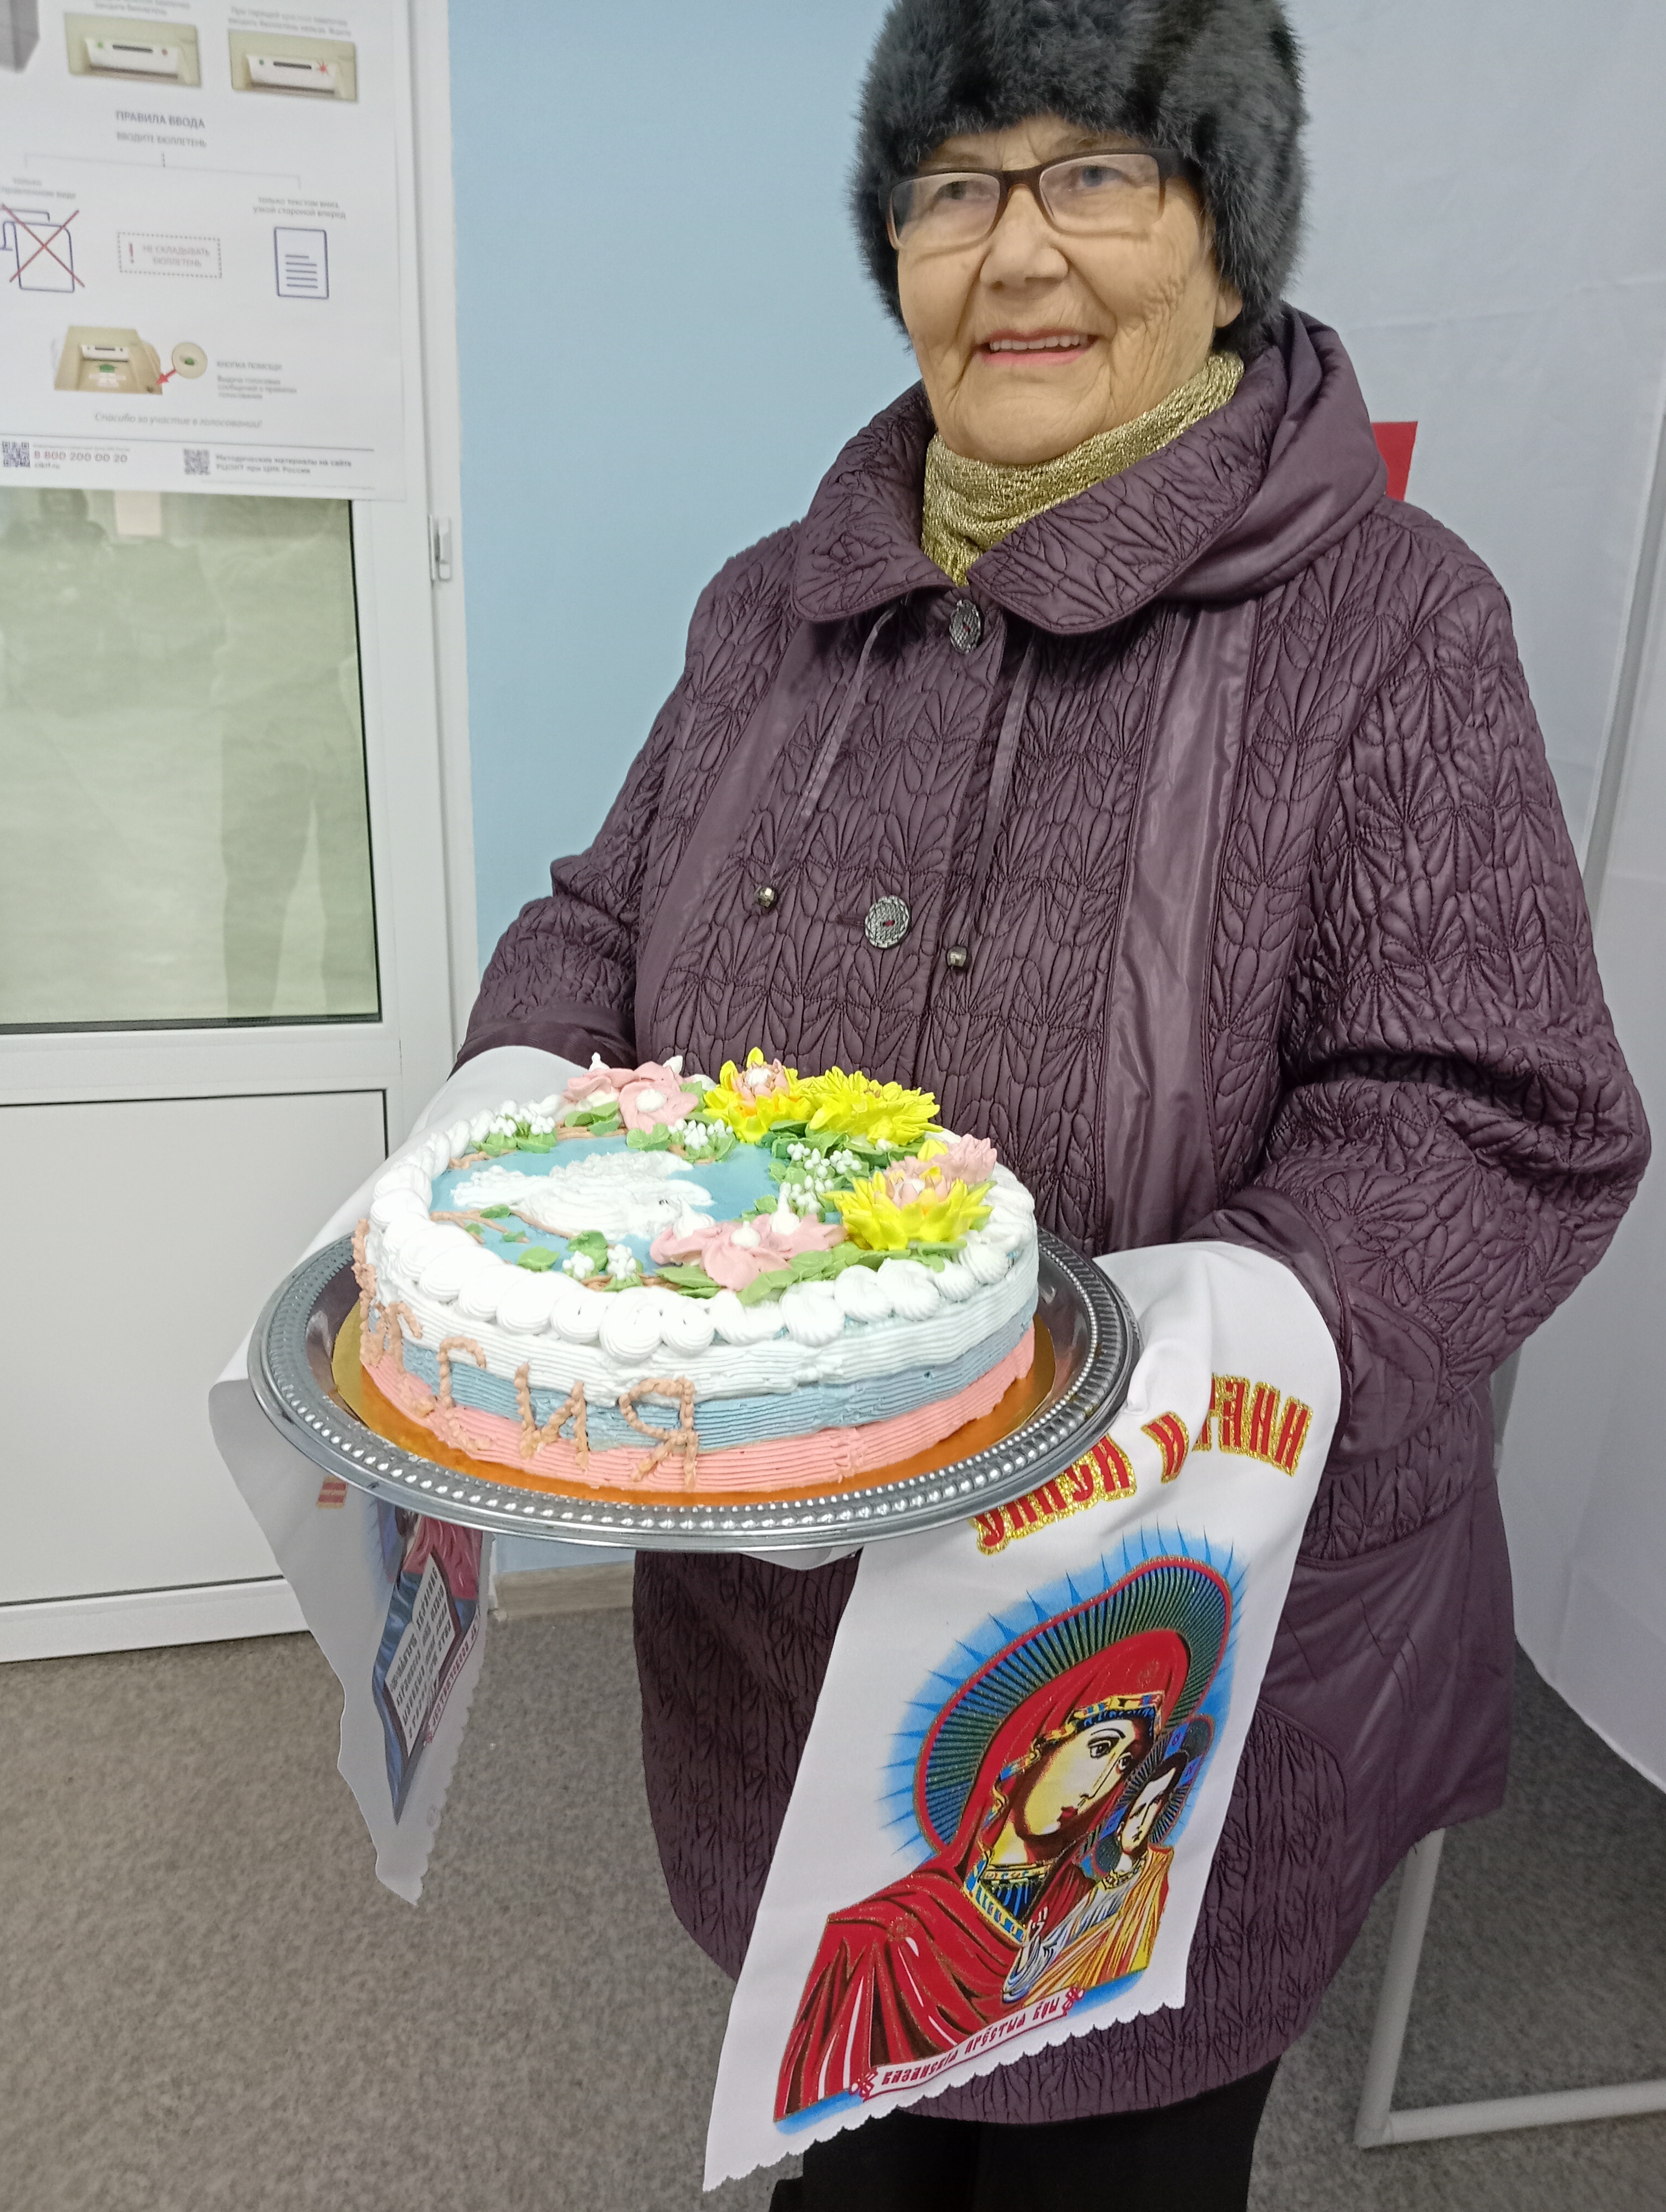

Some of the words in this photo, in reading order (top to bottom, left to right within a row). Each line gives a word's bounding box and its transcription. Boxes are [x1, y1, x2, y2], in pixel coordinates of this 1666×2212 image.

[116, 110, 167, 125] ПРАВИЛА
[168, 114, 206, 130] ВВОДА
[117, 132, 155, 144] ВВОДИТЕ
[157, 136, 207, 148] БЮЛЛЕТЕНЬ
[70, 452, 92, 462] 200
[95, 453, 110, 463] 00
[113, 454, 128, 464] 20
